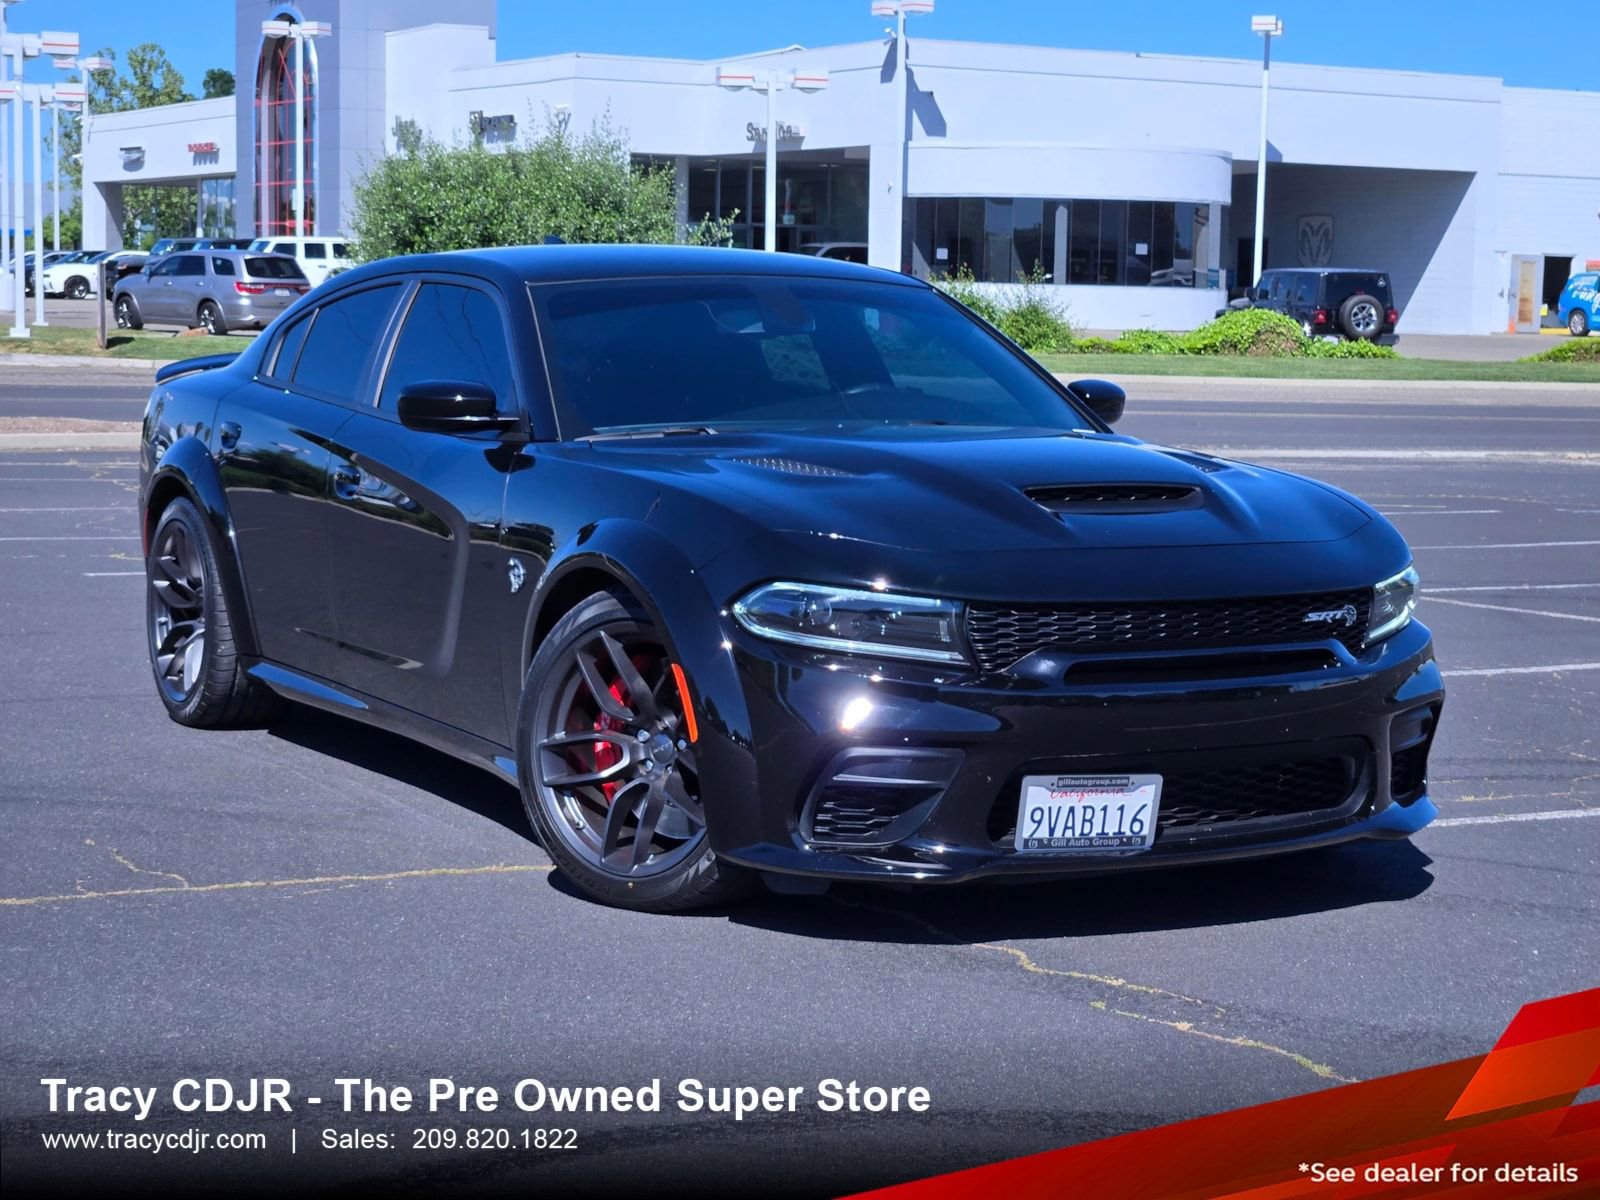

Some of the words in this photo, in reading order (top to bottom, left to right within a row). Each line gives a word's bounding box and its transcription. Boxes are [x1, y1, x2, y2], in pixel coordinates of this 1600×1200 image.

[1058, 777, 1129, 787] gillautogroup.com
[1029, 803, 1148, 838] 9VAB116
[1051, 838, 1068, 847] Gill
[1070, 838, 1090, 847] Auto
[1092, 837, 1121, 847] Group
